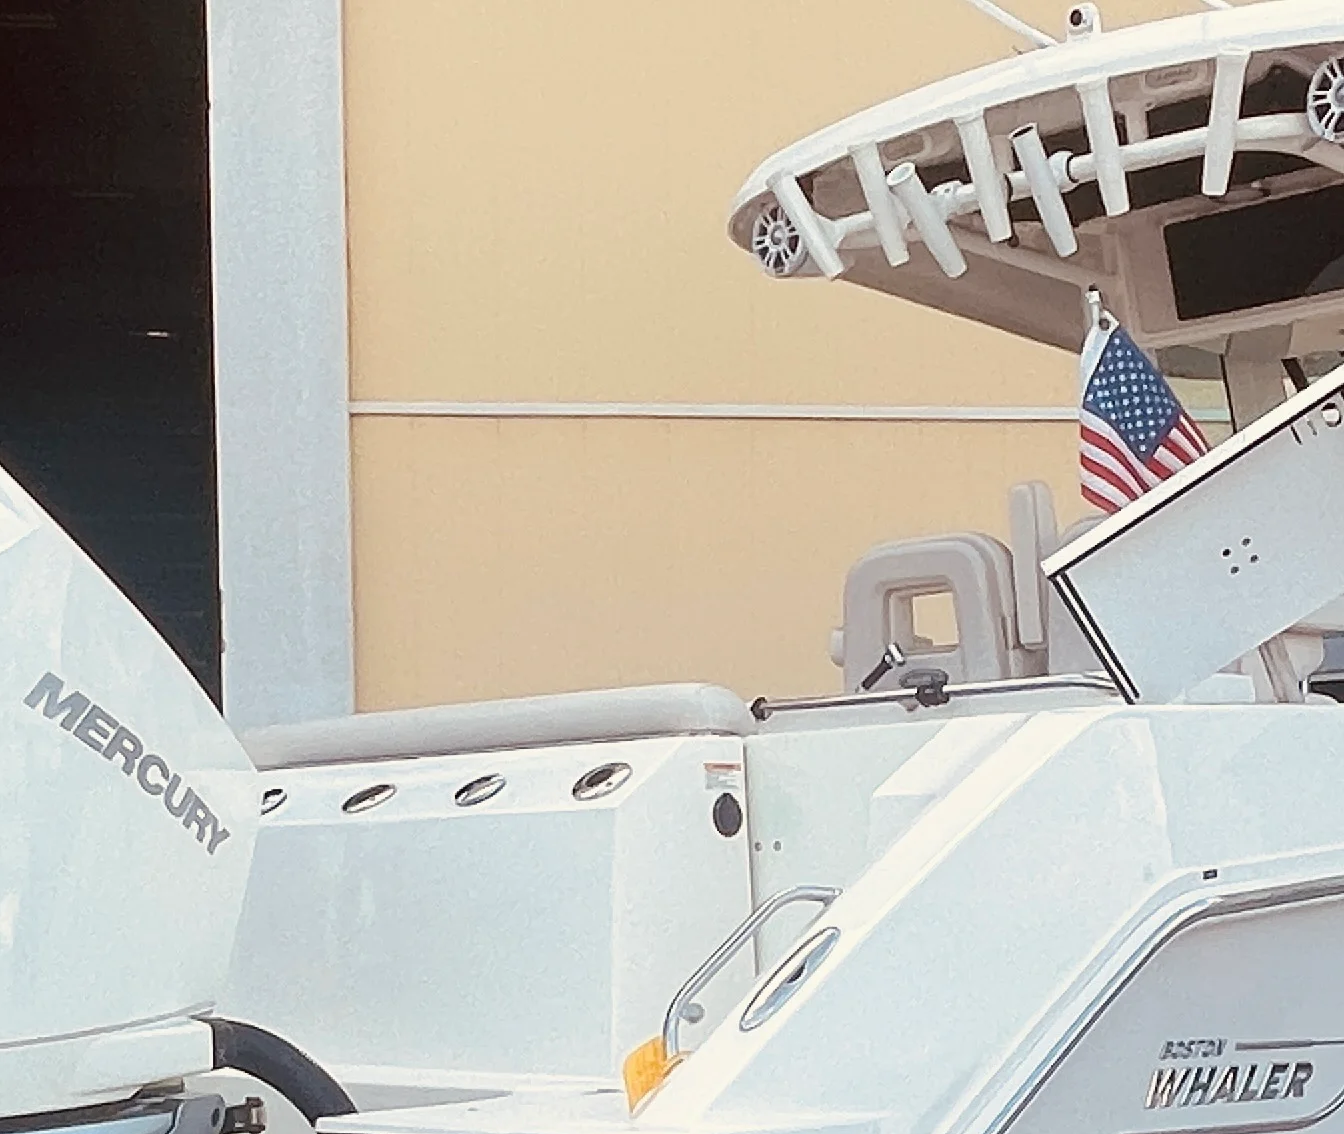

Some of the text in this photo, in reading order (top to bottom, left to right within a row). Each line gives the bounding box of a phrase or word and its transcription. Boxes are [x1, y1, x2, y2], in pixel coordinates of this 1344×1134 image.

[23, 672, 231, 856] MERCURY
[1159, 1038, 1227, 1060] BOSTON
[1144, 1061, 1314, 1110] WHALER
